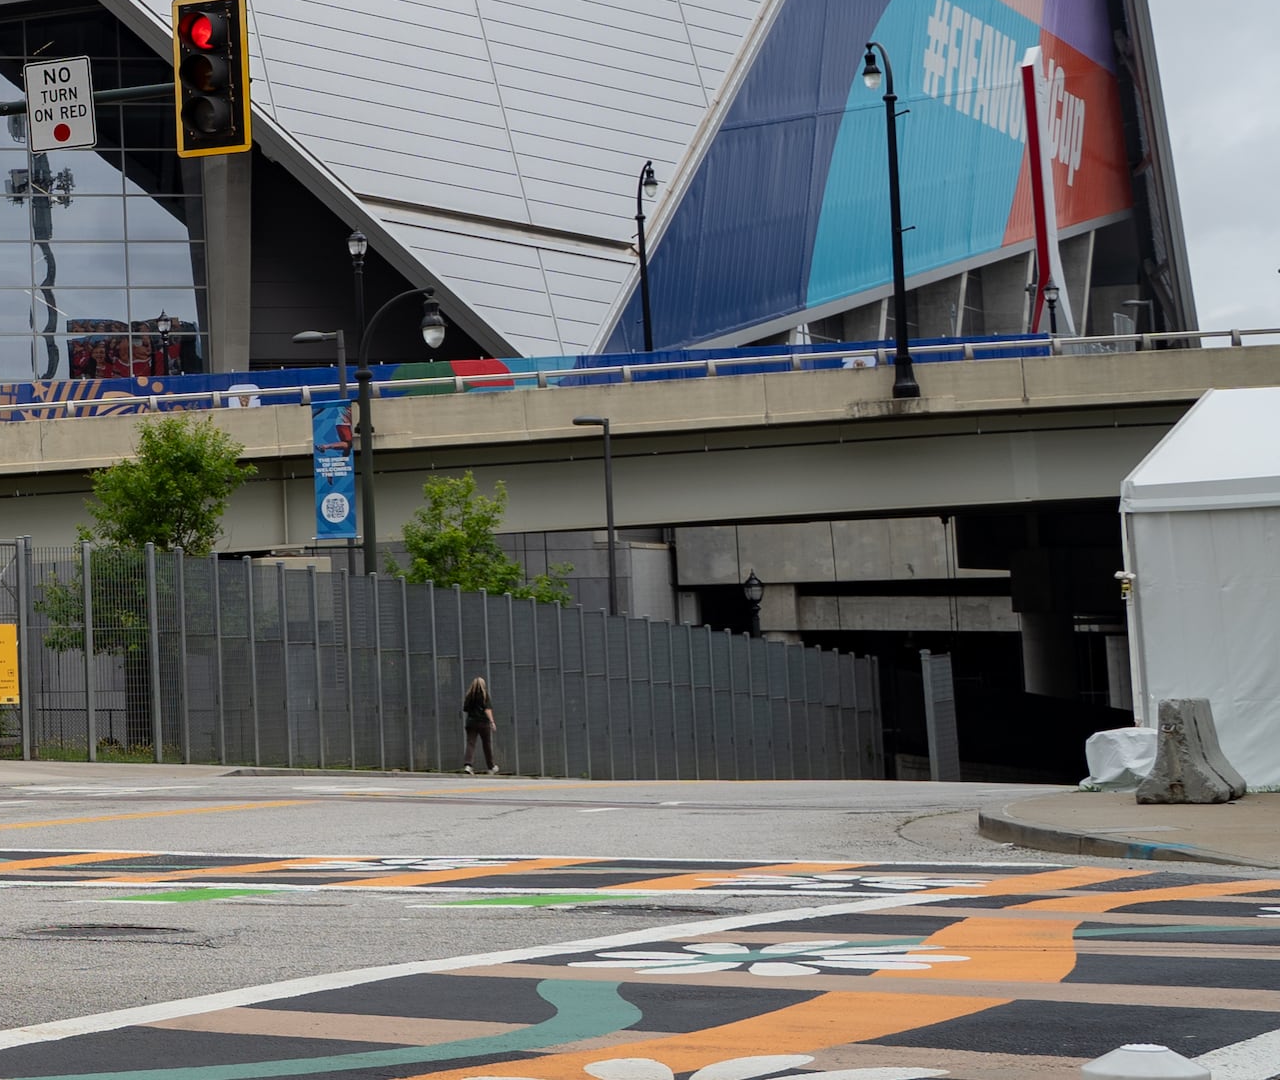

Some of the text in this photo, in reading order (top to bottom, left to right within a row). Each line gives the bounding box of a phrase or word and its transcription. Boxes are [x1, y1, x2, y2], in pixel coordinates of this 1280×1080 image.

[43, 67, 70, 85] NO
[41, 87, 77, 103] TURN
[35, 104, 87, 122] ON RED
